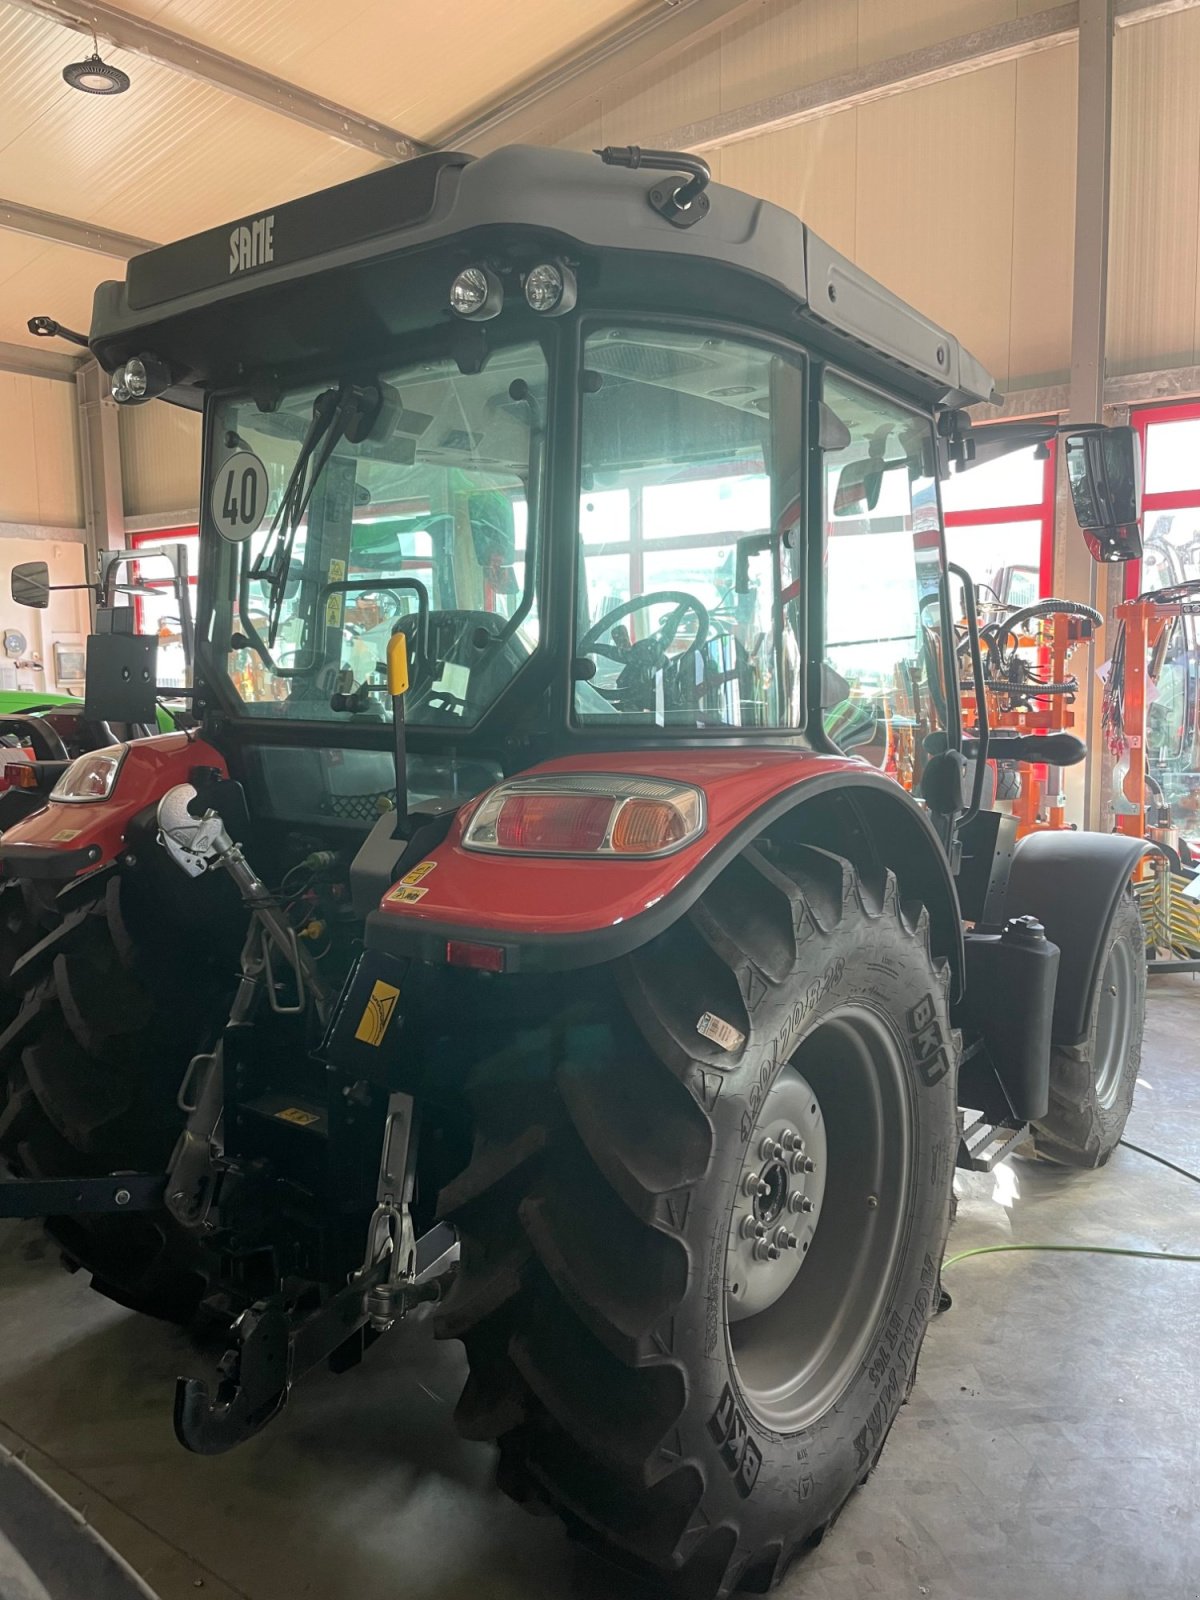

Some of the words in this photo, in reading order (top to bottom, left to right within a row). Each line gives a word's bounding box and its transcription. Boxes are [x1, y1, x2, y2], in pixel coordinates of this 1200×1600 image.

[229, 214, 275, 275] SAME
[222, 467, 257, 526] 40
[907, 992, 950, 1087] BKT
[868, 1347, 891, 1388] 765
[705, 1381, 763, 1499] BKT
